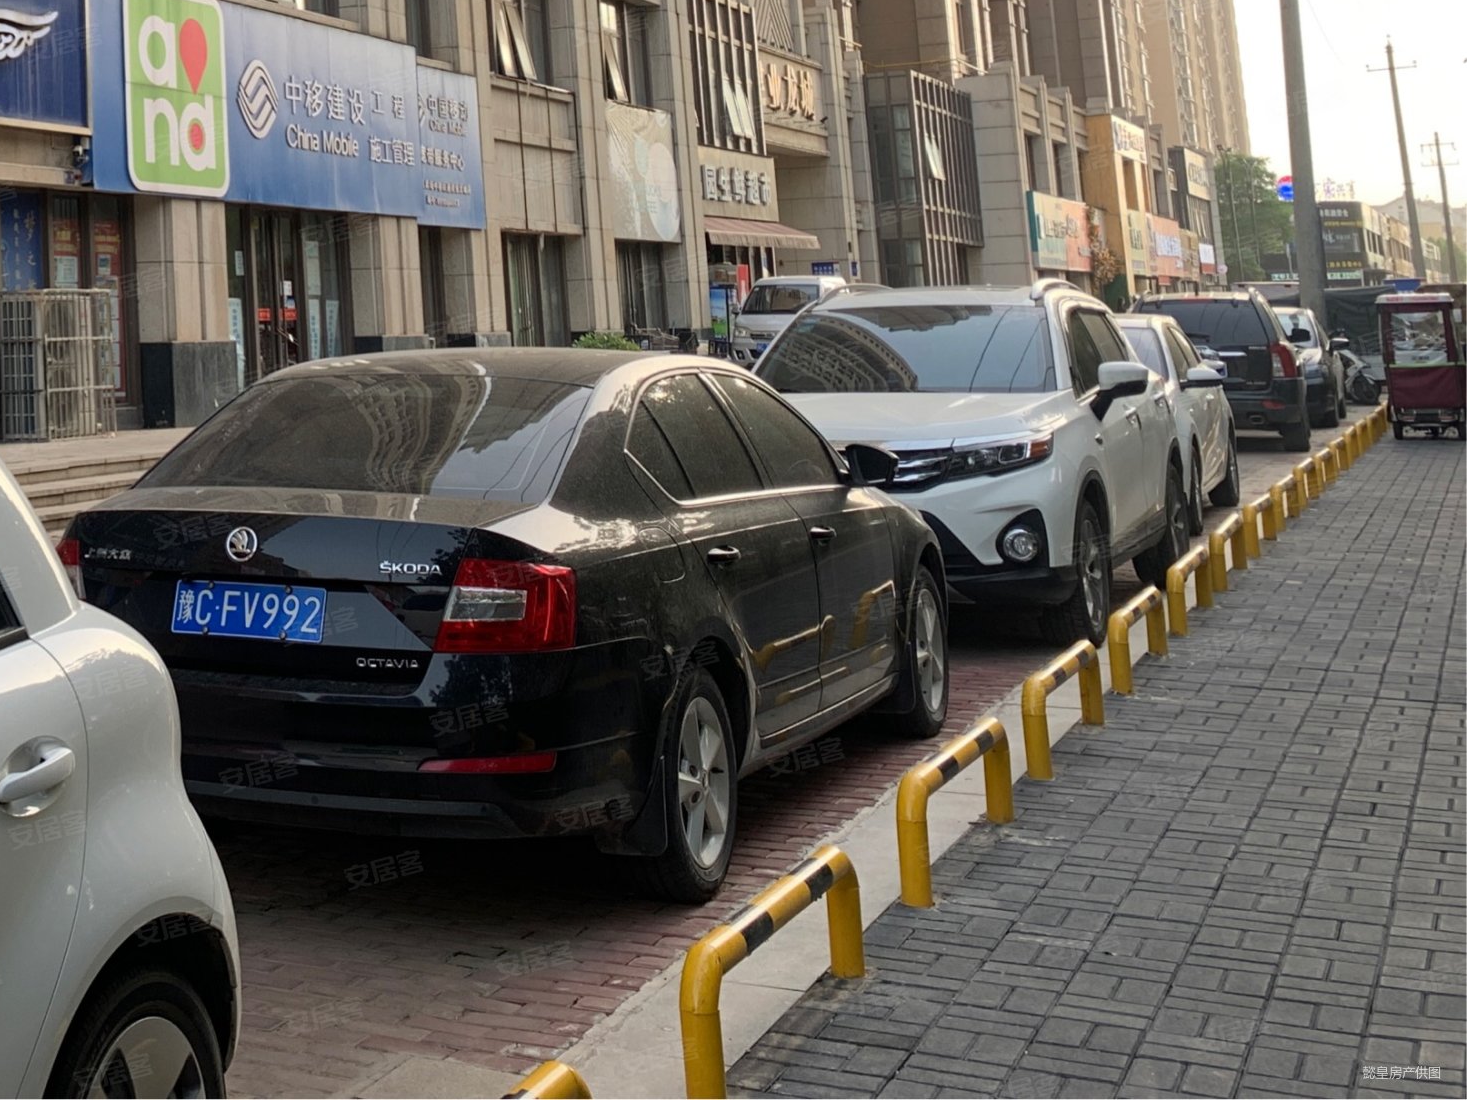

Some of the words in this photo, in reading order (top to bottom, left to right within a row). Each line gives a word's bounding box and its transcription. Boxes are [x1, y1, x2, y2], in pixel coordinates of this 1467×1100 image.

[286, 123, 319, 152] China
[322, 130, 359, 157] Mobile
[355, 657, 419, 669] OCTAVIA
